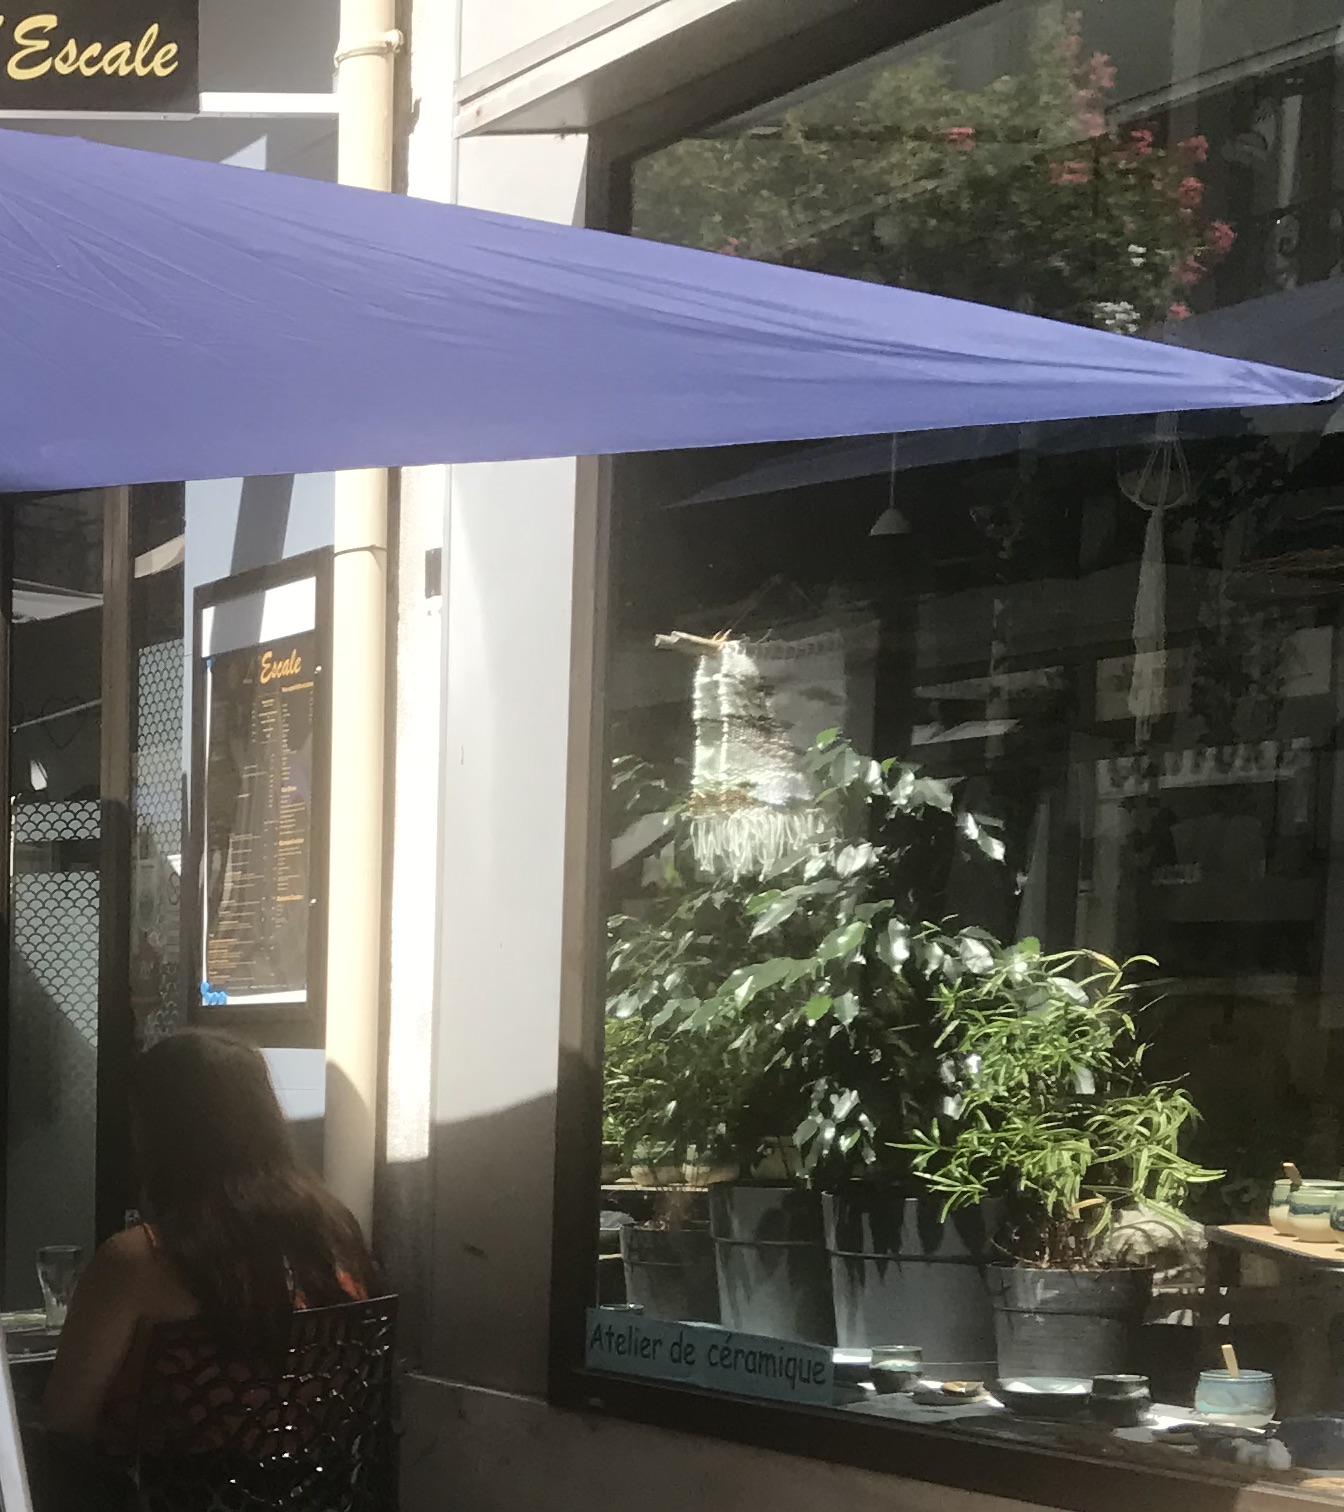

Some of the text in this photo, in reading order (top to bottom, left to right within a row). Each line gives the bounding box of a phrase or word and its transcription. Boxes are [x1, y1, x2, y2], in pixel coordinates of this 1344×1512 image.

[590, 1323, 826, 1391] Atelier de céramique
